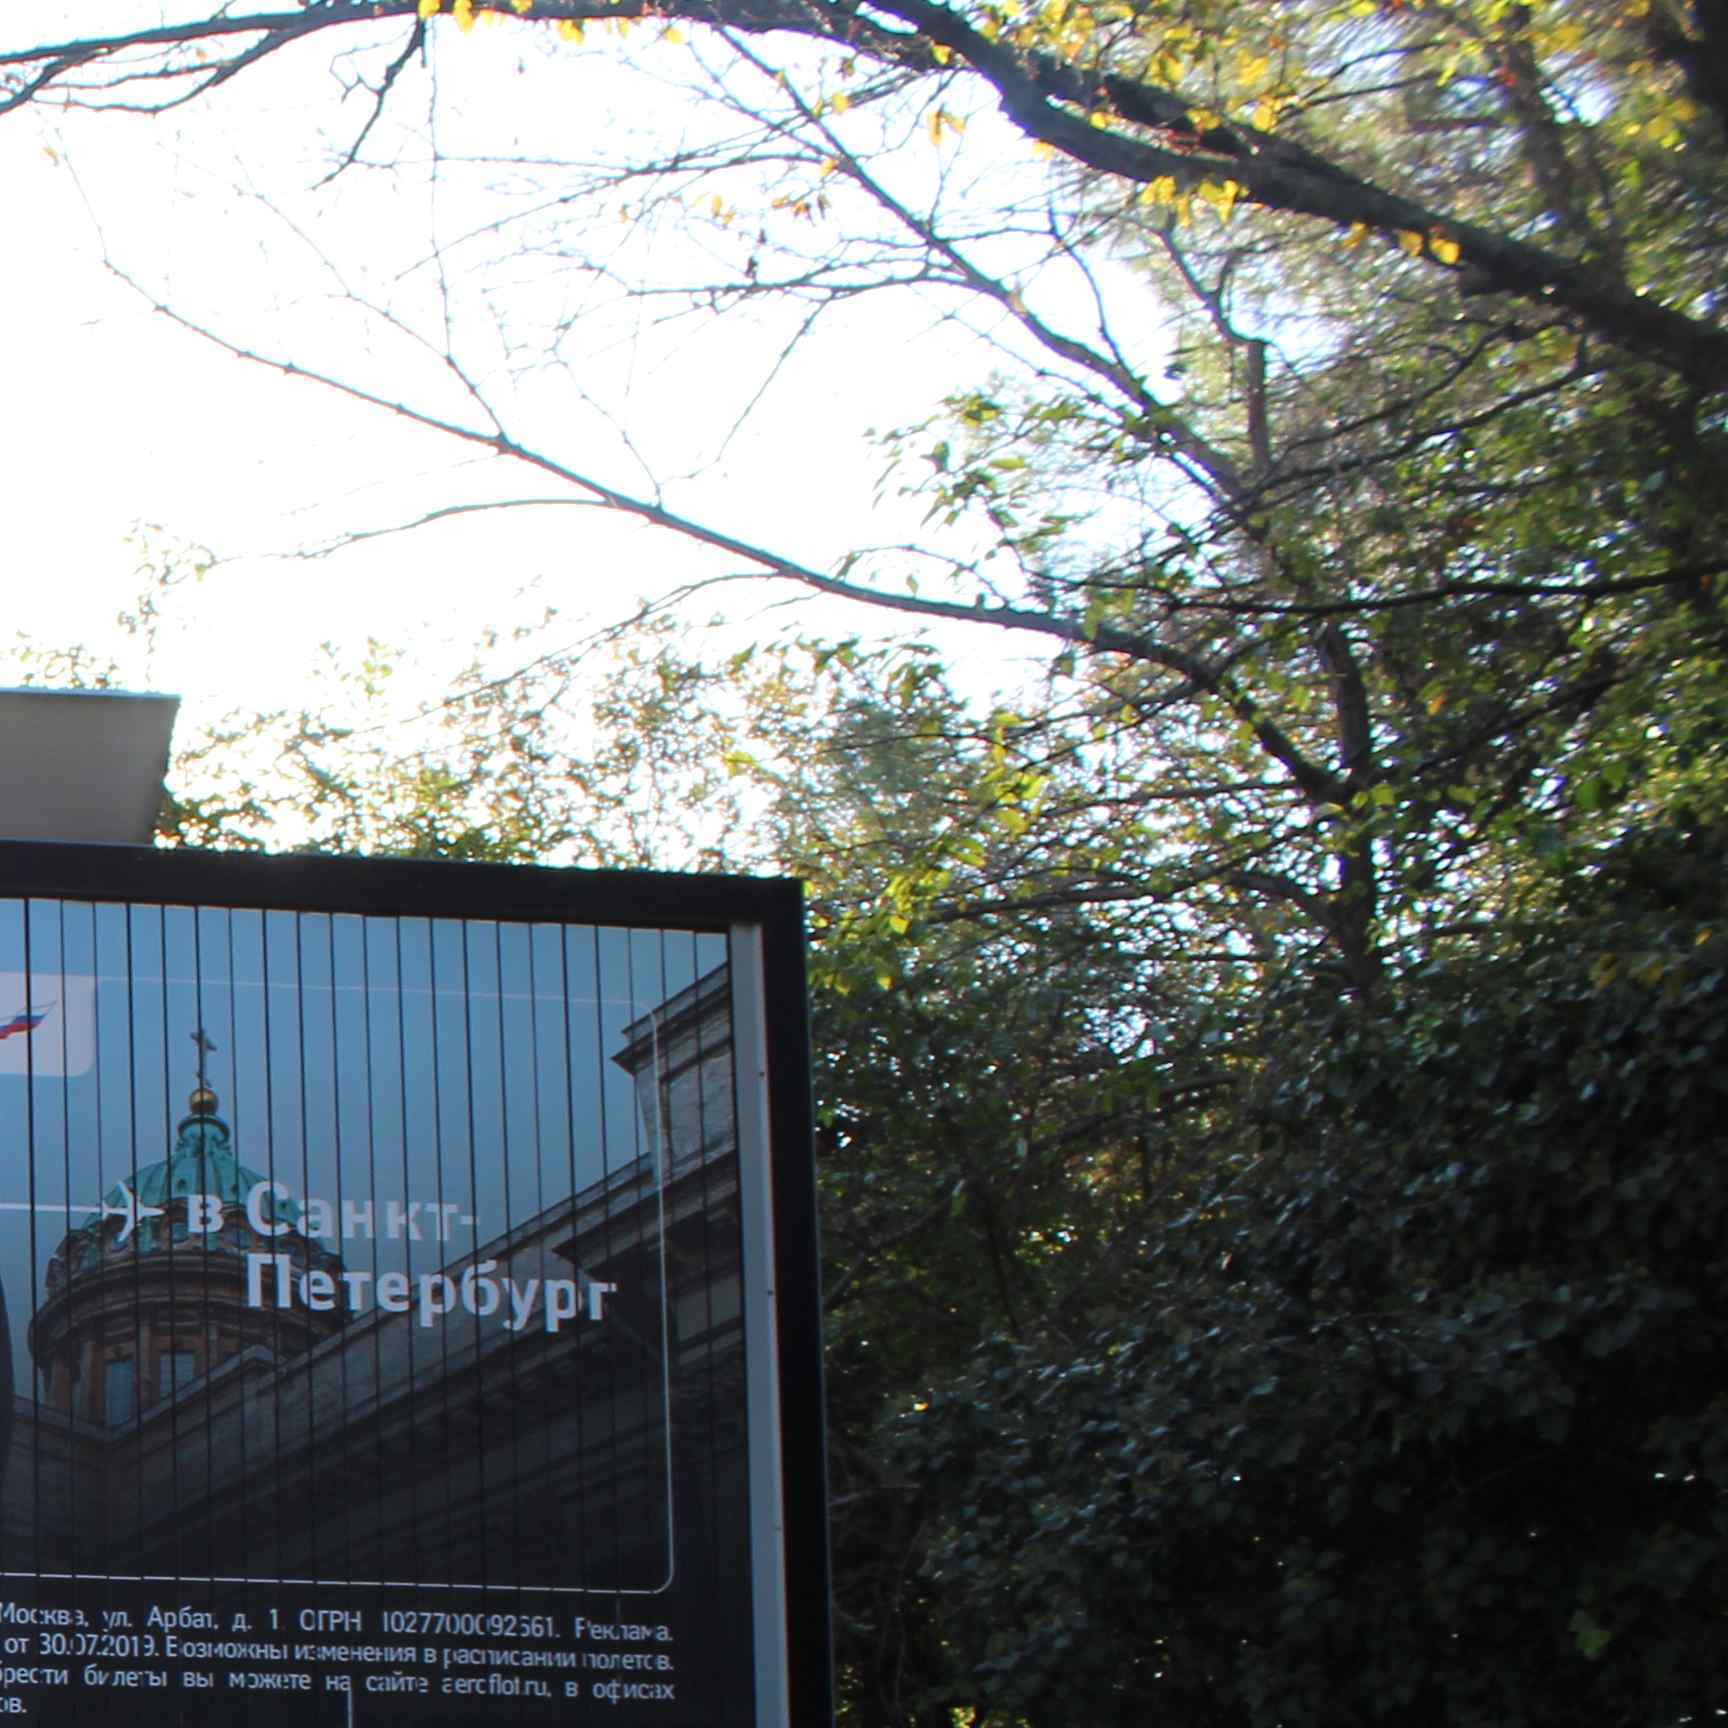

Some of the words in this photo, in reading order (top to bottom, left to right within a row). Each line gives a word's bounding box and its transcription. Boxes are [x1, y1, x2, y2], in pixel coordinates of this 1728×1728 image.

[187, 1194, 224, 1234] в
[246, 1180, 479, 1242] Санкт-
[246, 1252, 617, 1333] Петербург
[102, 1608, 133, 1633] ул.
[231, 1610, 253, 1632] д.
[299, 1608, 363, 1632] ОГРН
[4, 1637, 30, 1654] от
[166, 1634, 288, 1660] Возможны
[294, 1643, 416, 1664] изменения
[423, 1647, 437, 1664] в
[443, 1648, 576, 1670] расписании
[84, 1662, 167, 1688] билеты
[183, 1670, 214, 1688] вы
[229, 1672, 312, 1691] можете
[325, 1674, 352, 1692] на
[366, 1670, 429, 1694] сайте
[565, 1681, 578, 1698] в
[593, 1680, 675, 1705] офисах
